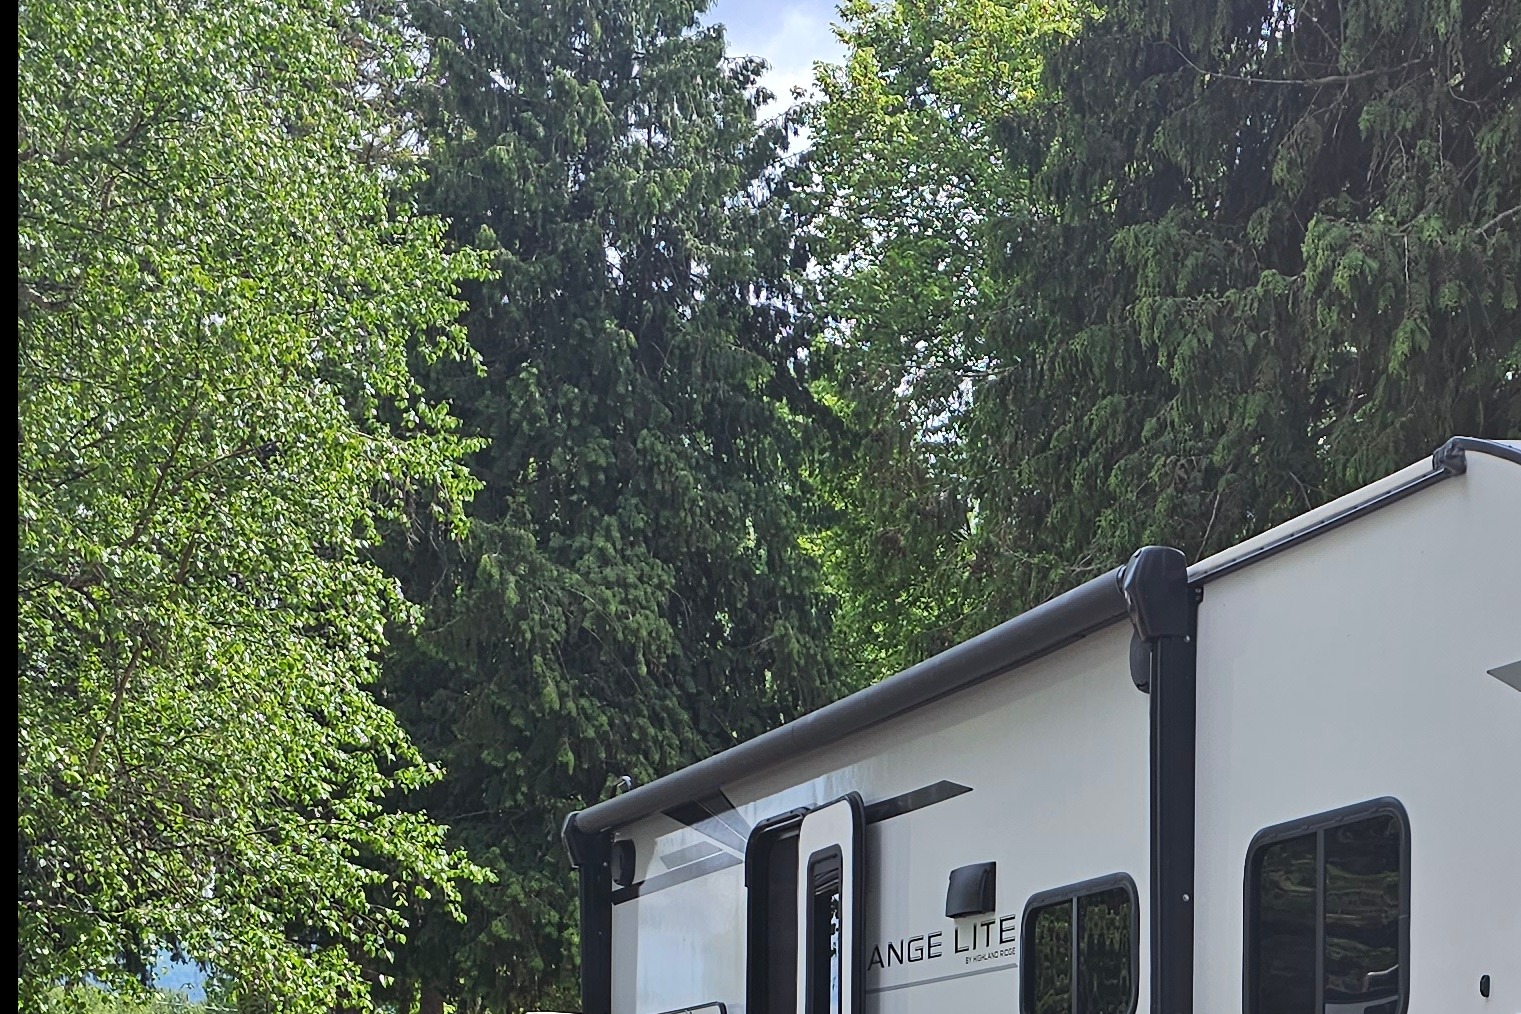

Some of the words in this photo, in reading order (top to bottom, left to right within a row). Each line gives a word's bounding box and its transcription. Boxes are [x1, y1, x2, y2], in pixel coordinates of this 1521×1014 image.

[867, 931, 943, 971] ANGE
[954, 914, 1016, 954] LITE
[965, 956, 972, 964] BY
[972, 950, 999, 963] HIGHLAND
[999, 946, 1016, 957] RIDGE
